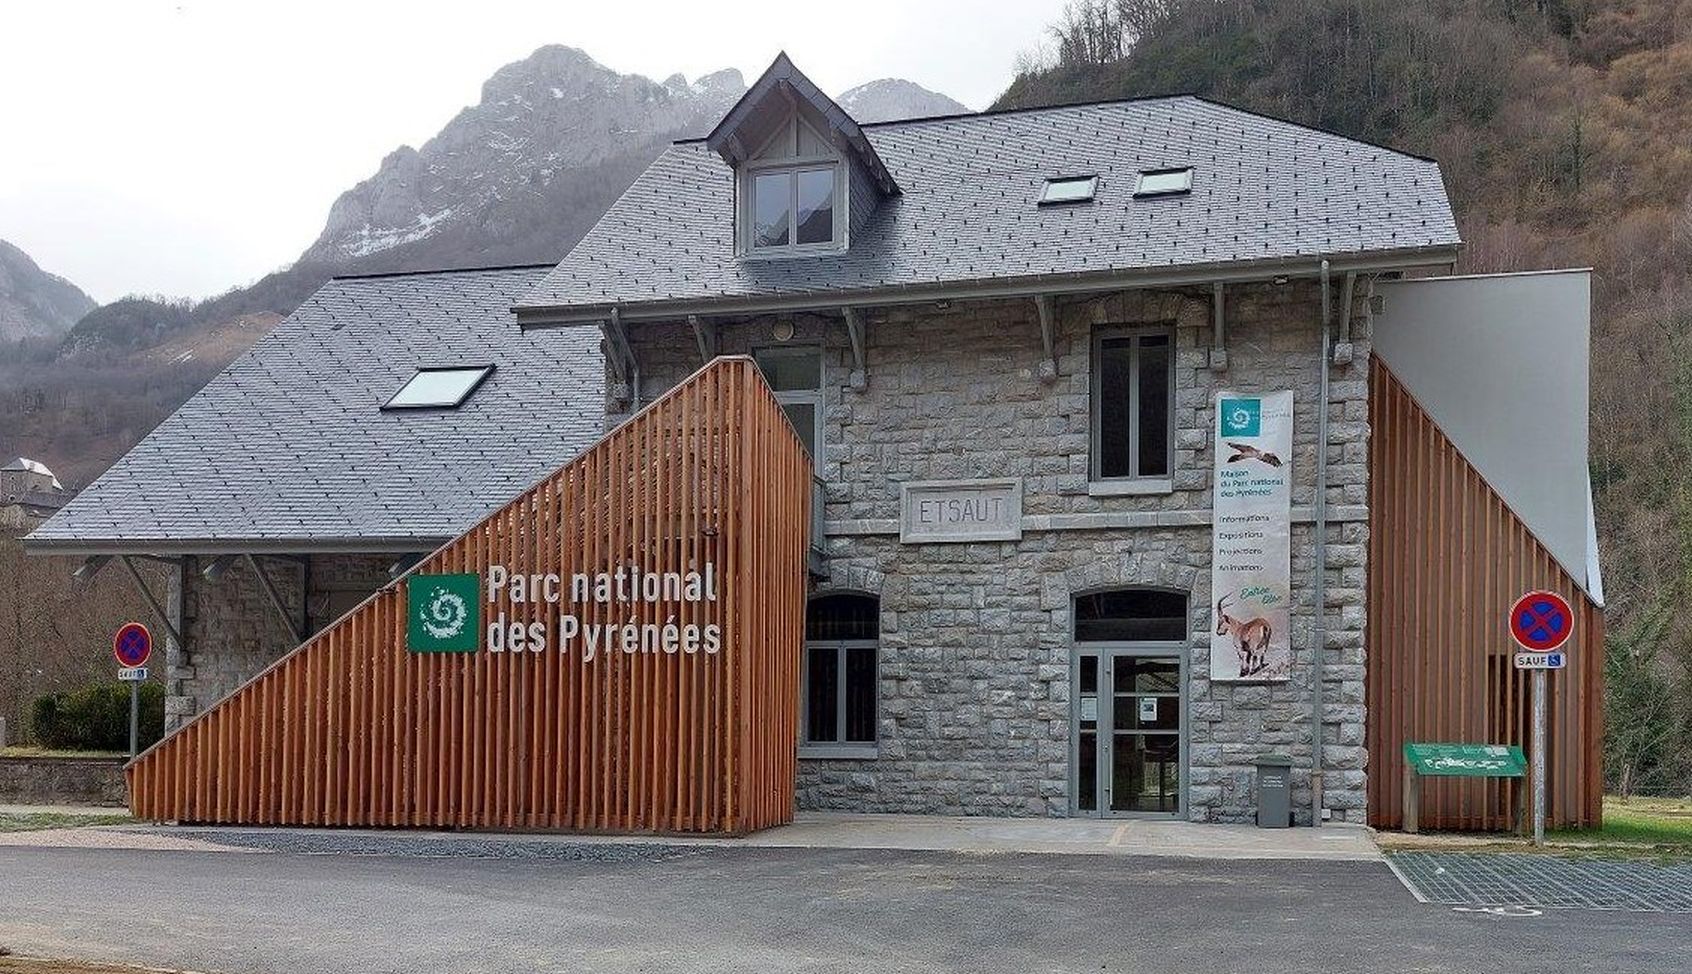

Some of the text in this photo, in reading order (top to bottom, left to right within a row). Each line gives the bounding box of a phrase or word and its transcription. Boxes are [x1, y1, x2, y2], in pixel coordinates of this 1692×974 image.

[1251, 478, 1284, 486] national
[920, 498, 1003, 523] ETSAUT
[1219, 514, 1271, 523] Informations
[1219, 531, 1264, 541] Expositions
[1219, 548, 1263, 558] Projections
[1219, 564, 1264, 572] Animations
[487, 562, 717, 603] Parc national
[486, 612, 722, 663] des Pyrénées
[1518, 656, 1547, 666] SAUF
